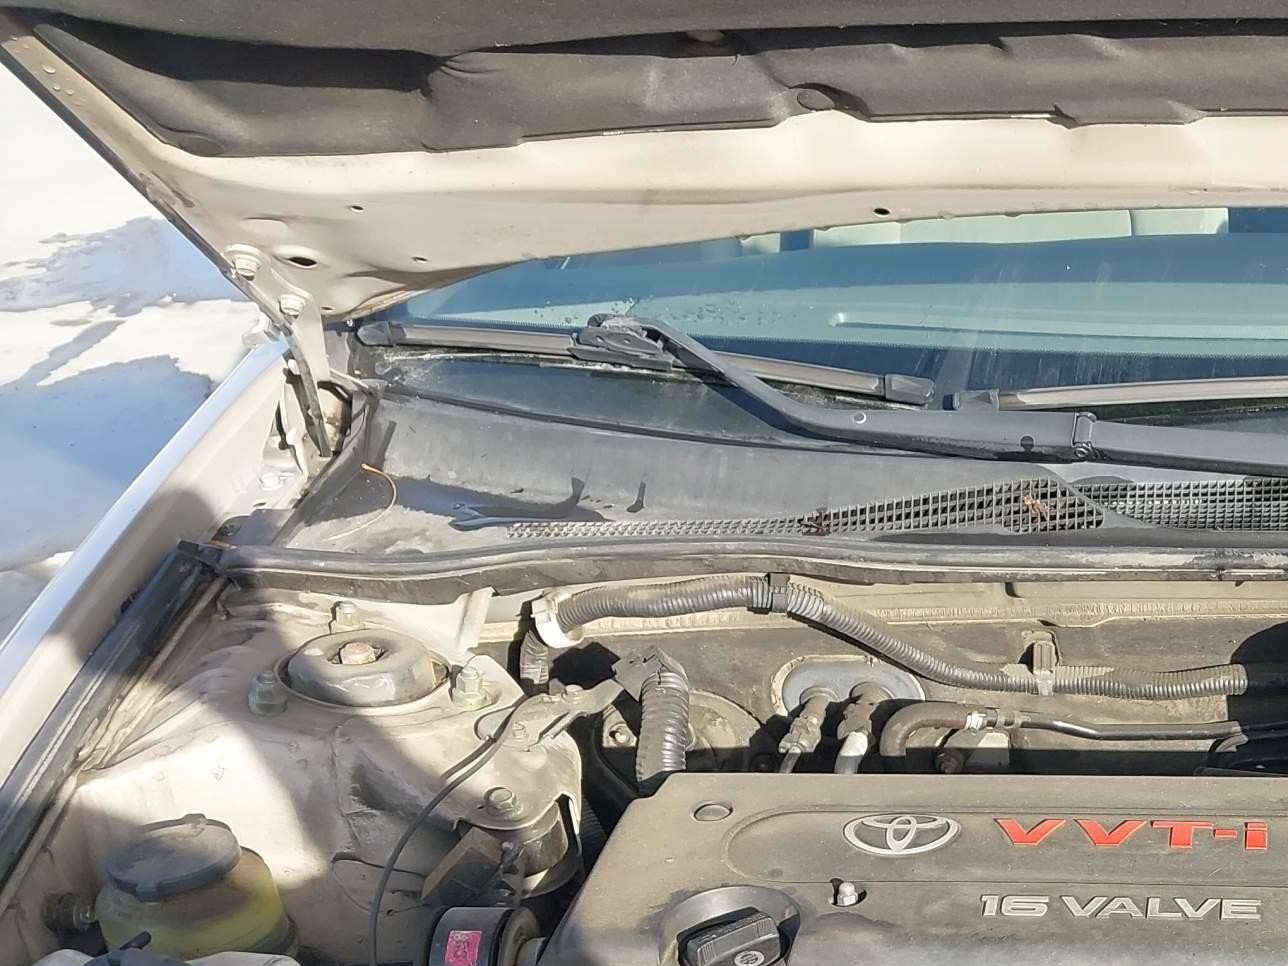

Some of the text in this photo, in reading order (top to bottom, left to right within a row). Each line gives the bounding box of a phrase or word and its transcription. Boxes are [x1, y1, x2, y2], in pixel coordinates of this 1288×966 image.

[993, 817, 1269, 851] VVT-i
[980, 894, 1263, 920] 16 VALVE
